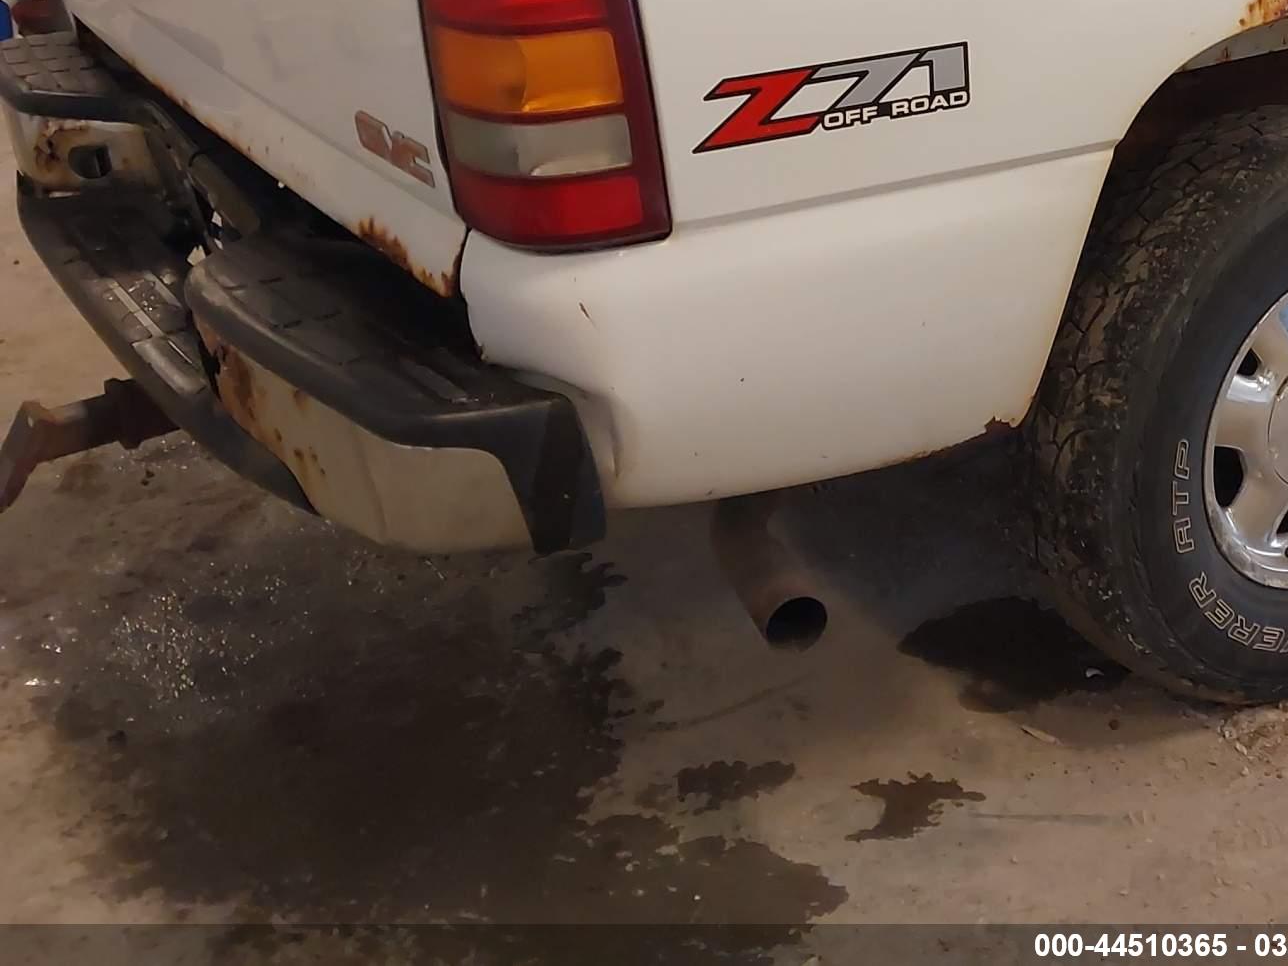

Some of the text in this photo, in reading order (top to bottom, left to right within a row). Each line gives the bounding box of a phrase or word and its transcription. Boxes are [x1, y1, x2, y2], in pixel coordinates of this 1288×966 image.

[691, 41, 970, 154] Z71
[823, 89, 969, 129] OFF ROAD
[1171, 437, 1191, 554] ATP
